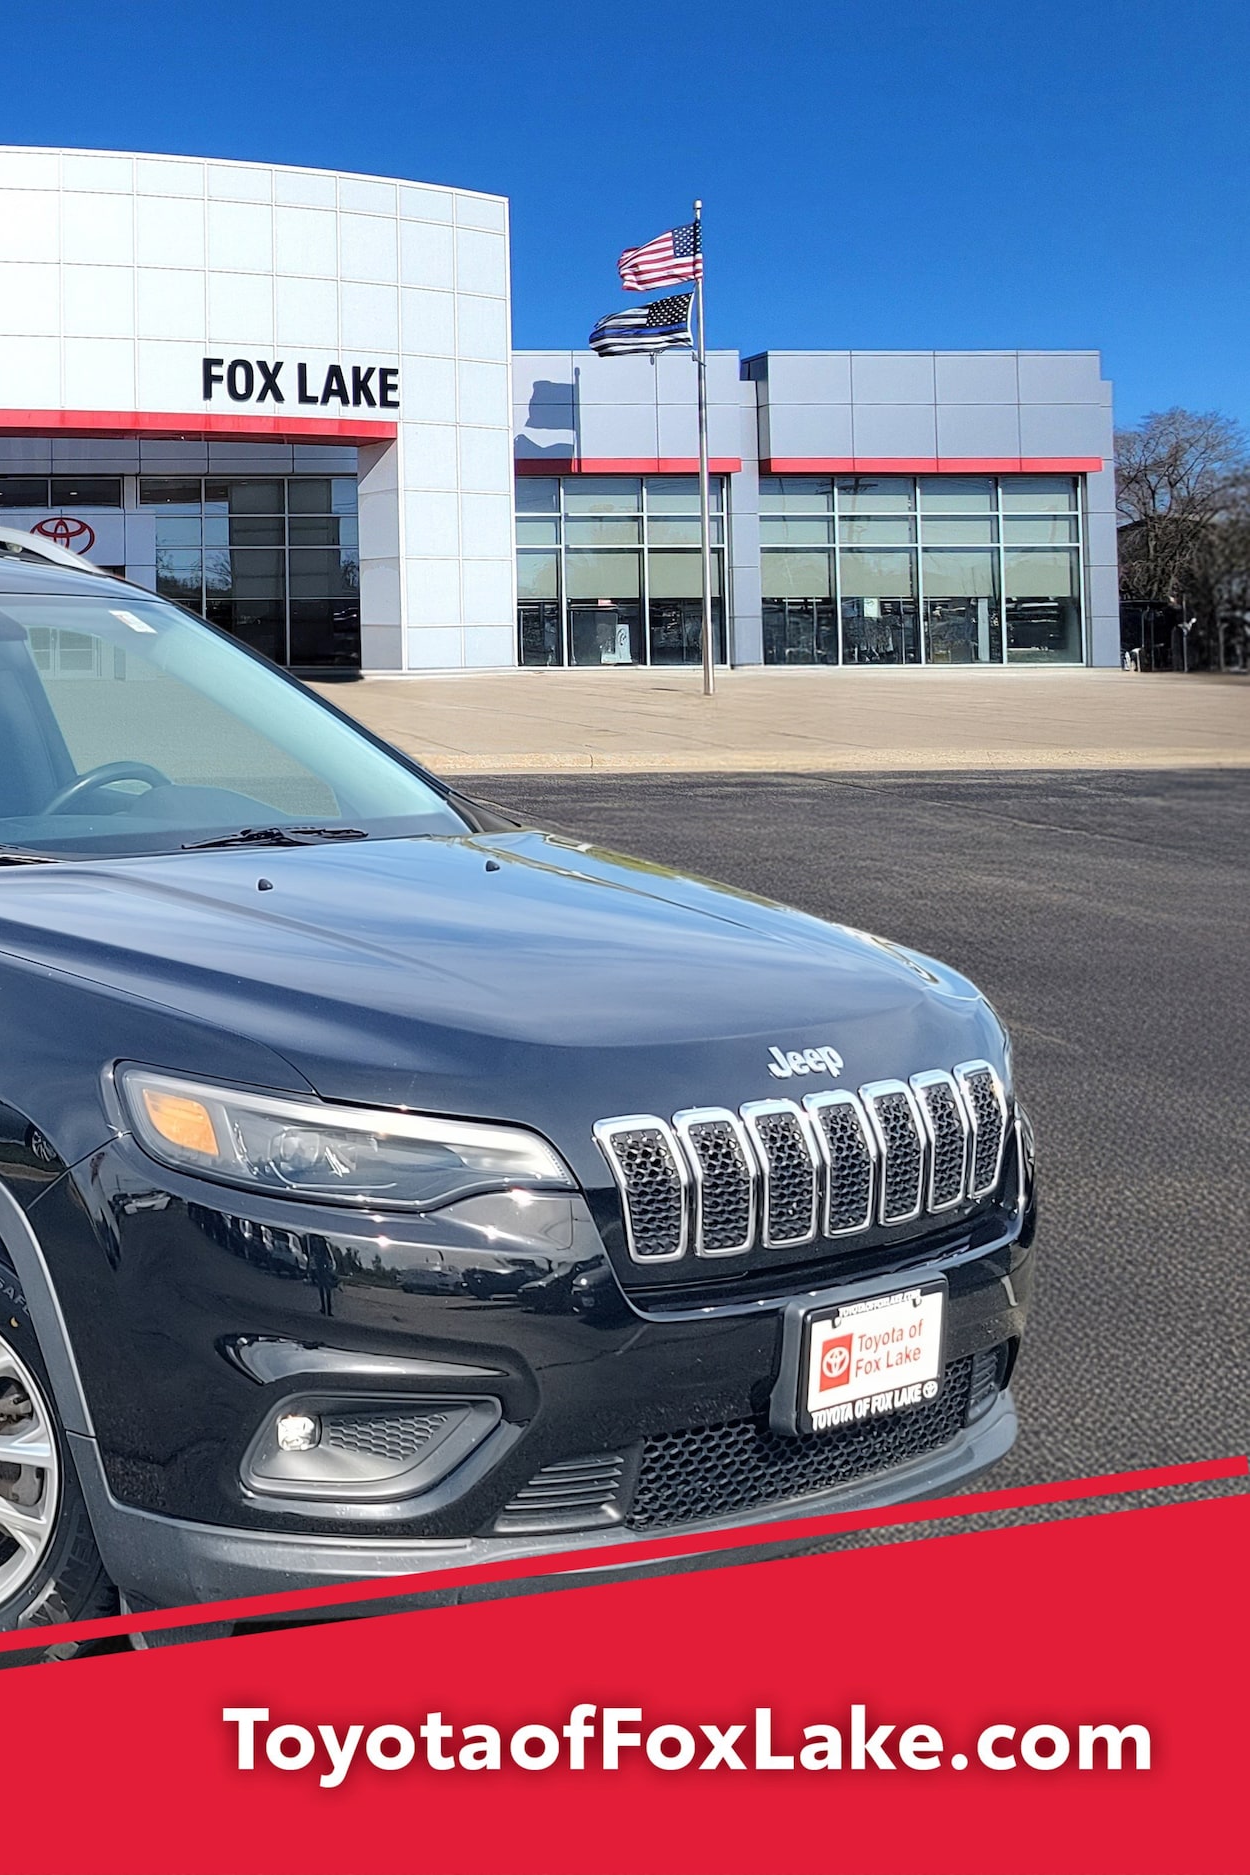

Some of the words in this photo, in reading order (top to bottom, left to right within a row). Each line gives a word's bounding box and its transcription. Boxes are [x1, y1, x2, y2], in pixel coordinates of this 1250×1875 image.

[203, 358, 285, 403] FOX
[297, 362, 400, 408] LAKE
[766, 1046, 845, 1079] Jeep
[858, 1326, 904, 1354] Toyota
[908, 1317, 924, 1338] of
[855, 1357, 881, 1378] Fox
[886, 1344, 921, 1368] Lake
[811, 1402, 853, 1432] TOYOTA
[854, 1397, 871, 1419] OF
[870, 1390, 893, 1415] FOX
[893, 1383, 923, 1409] LAKE
